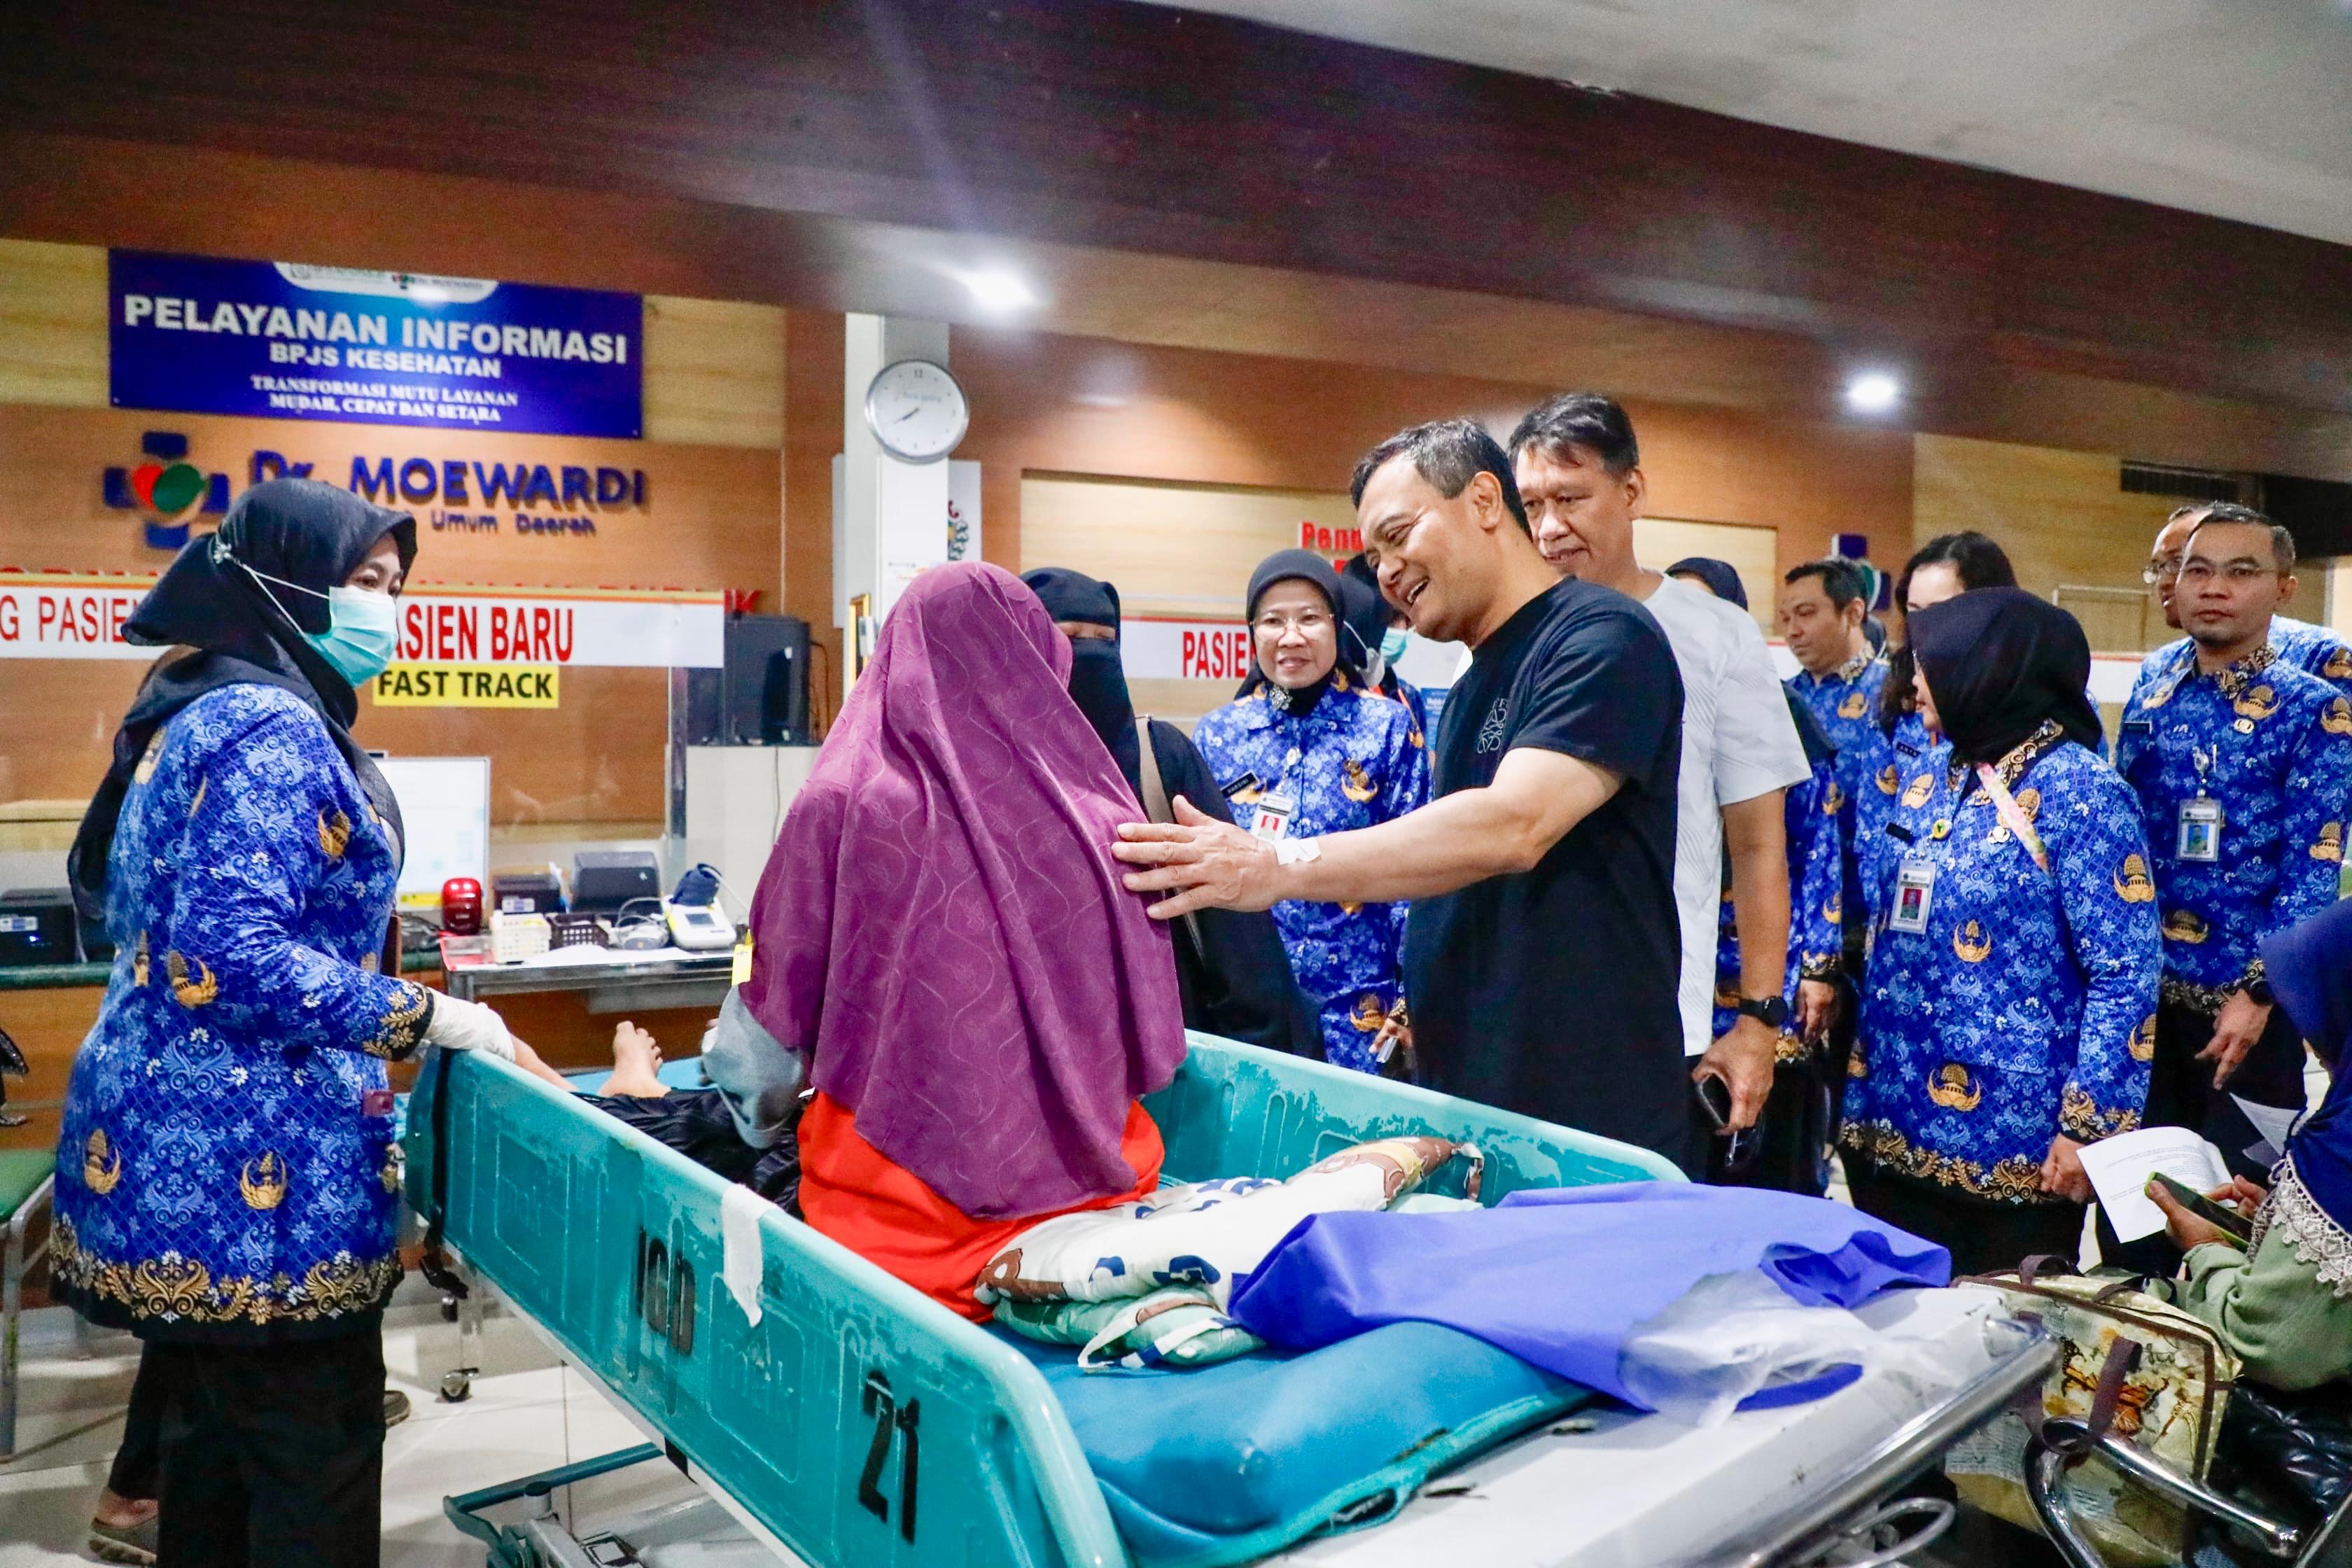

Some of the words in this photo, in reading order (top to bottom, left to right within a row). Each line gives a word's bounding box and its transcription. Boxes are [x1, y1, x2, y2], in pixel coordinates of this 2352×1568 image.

[125, 294, 387, 345] PELAYANAN
[402, 316, 627, 365] INFORMASI
[270, 342, 339, 368] BPJS
[346, 348, 501, 379] KESEHATAN
[251, 374, 387, 399] TRANSFORMASI
[390, 384, 440, 402] MUTU
[442, 387, 518, 407] LAYANAN
[342, 398, 397, 416] CEPAT
[399, 400, 435, 418] DAN
[437, 403, 502, 423] SETARA
[349, 456, 645, 506] MOEWARDI
[430, 510, 498, 532] Umum
[38, 596, 140, 643] PASIE
[396, 603, 477, 661] SIEN
[491, 606, 573, 662] BARU
[1182, 631, 1257, 679] PASIE
[379, 670, 449, 696] FAST
[457, 671, 552, 699] TRACK
[858, 1369, 920, 1546] 21
